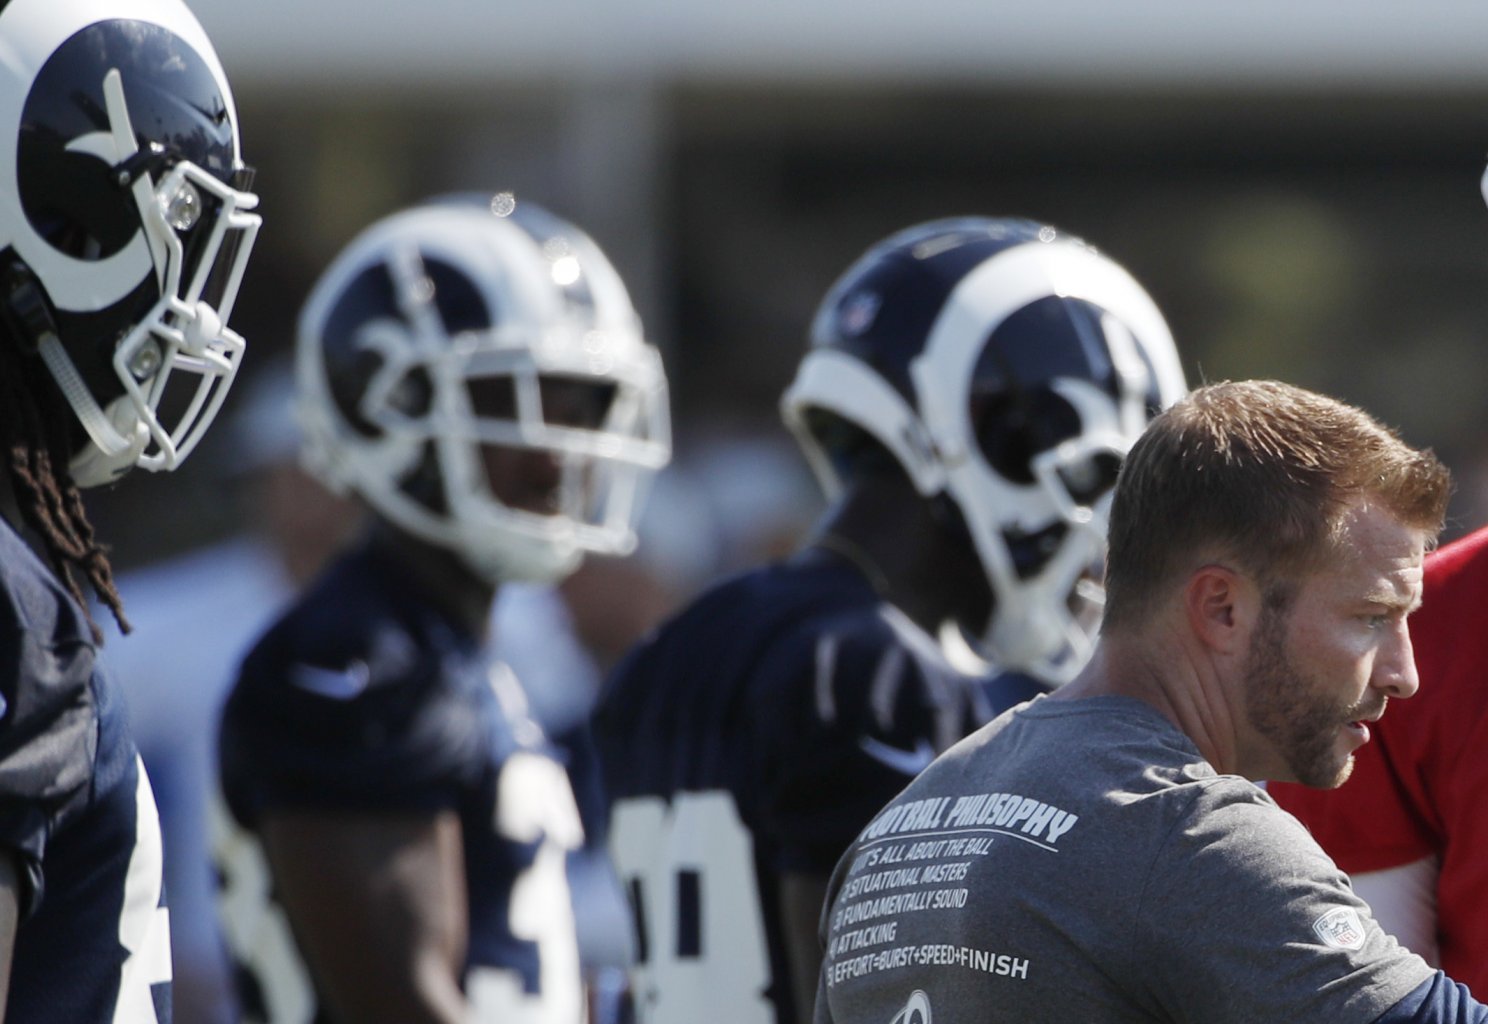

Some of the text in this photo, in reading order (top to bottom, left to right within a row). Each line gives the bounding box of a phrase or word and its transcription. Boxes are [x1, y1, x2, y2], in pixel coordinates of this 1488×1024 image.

[943, 793, 1080, 844] PHILOSOPHY
[879, 844, 906, 865] ALL
[904, 839, 949, 861] ABOUT
[943, 838, 965, 857] THE
[962, 838, 994, 856] BALL
[848, 867, 921, 899] SITUATIONAL
[920, 861, 972, 884] MASTERS
[842, 890, 935, 927] FUNDAMENTALLY
[932, 888, 969, 909] SOUND
[837, 922, 898, 955] ATTACKING
